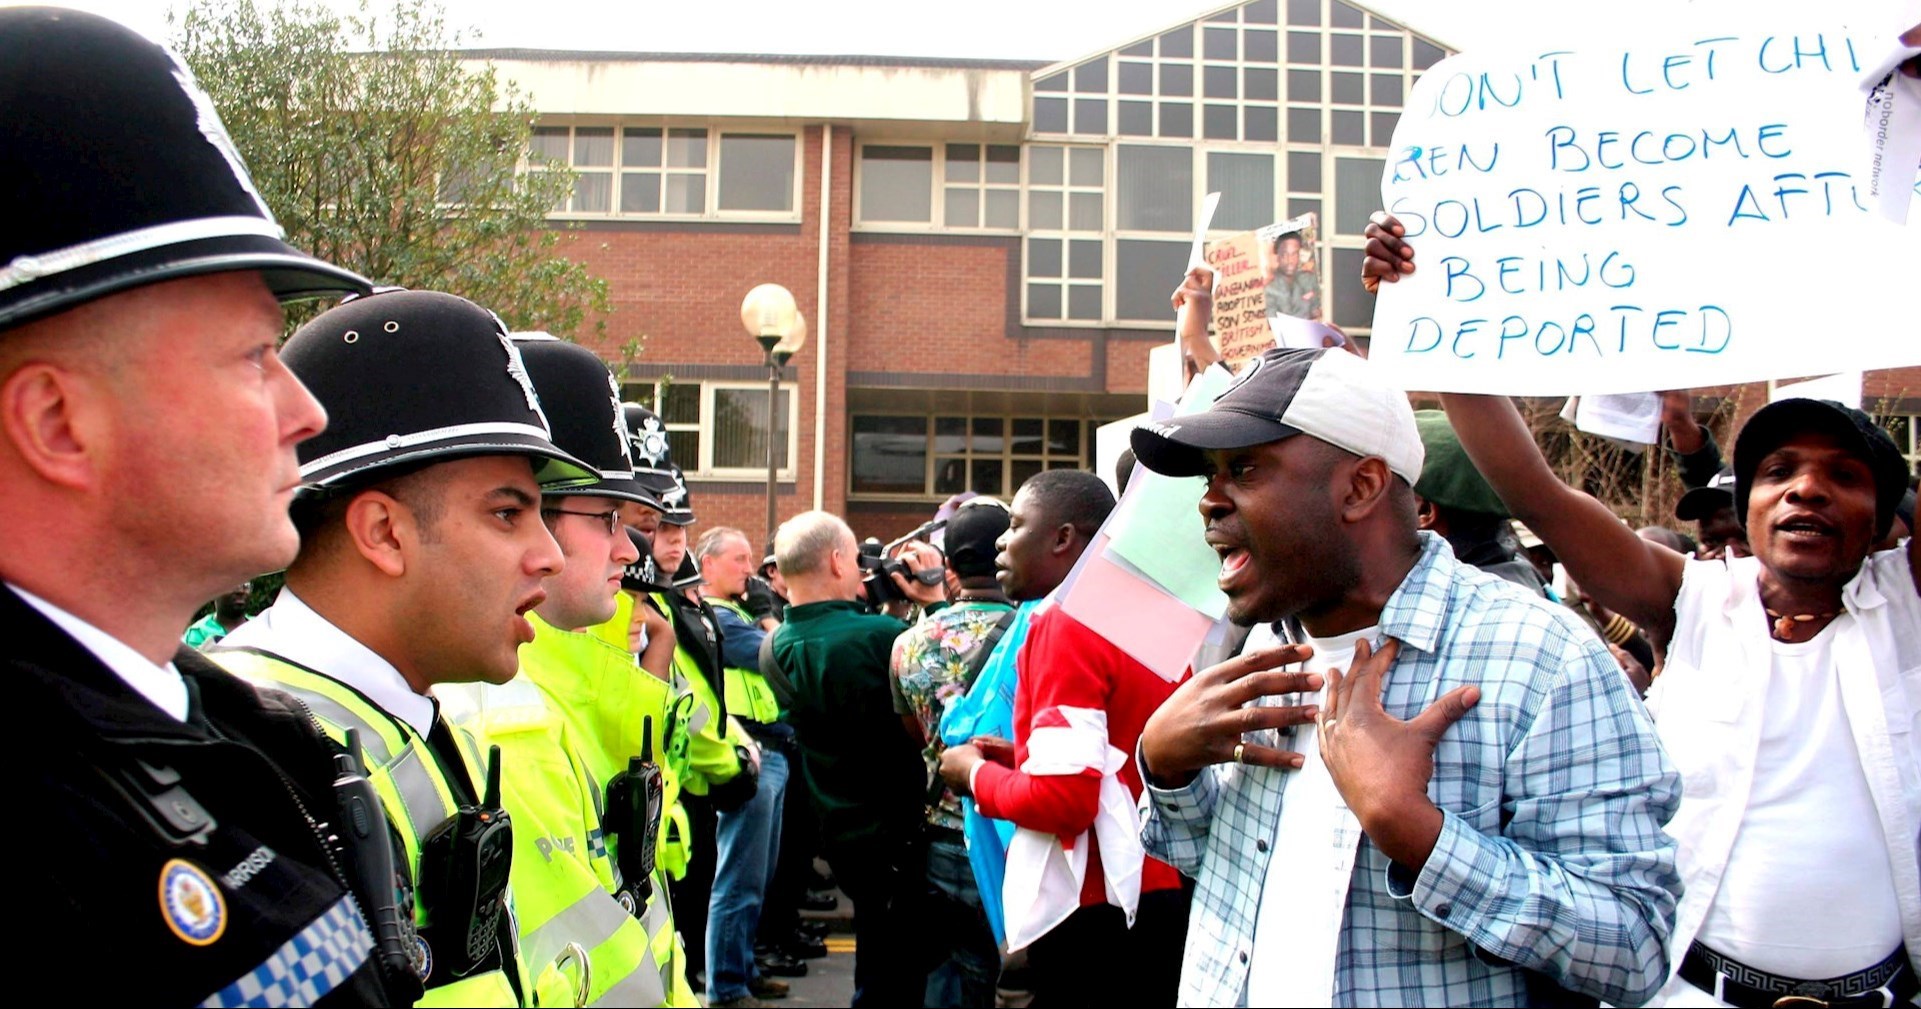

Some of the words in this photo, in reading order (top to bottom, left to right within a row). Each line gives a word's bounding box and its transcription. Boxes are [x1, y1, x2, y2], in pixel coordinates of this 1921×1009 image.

[1621, 36, 1740, 94] LET
[1545, 123, 1794, 172] BECOME
[1876, 91, 1894, 151] noborder
[1390, 180, 1689, 238] SOLDIERS
[1728, 171, 1868, 228] AFT
[1216, 292, 1264, 314] ADOPTIVE
[1440, 250, 1638, 303] BEING
[1217, 313, 1241, 330] SON
[1221, 323, 1264, 348] BRITISH
[1404, 304, 1733, 361] DEPORTED
